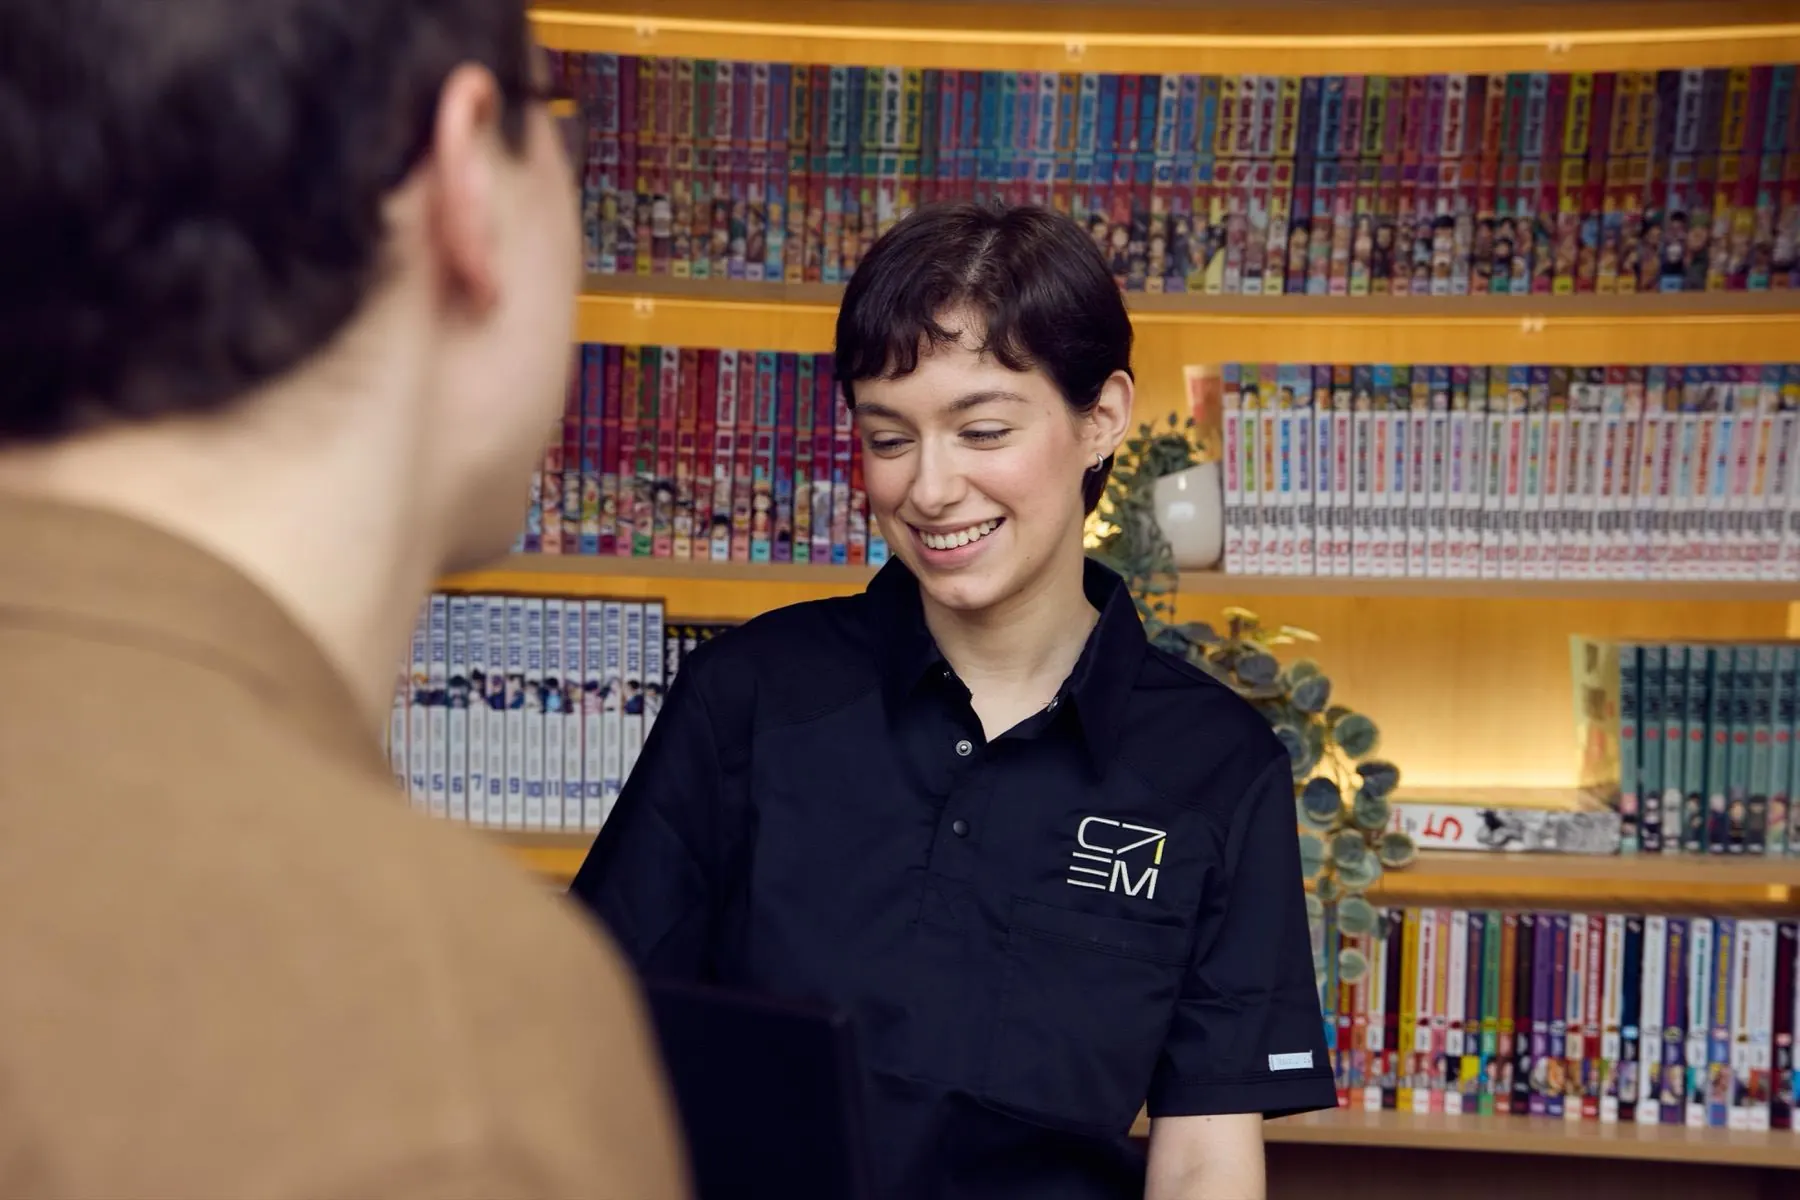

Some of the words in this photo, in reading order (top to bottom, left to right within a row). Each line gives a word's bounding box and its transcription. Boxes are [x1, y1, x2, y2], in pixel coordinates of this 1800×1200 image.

[1265, 540, 1277, 555] 4
[412, 774, 424, 791] 4
[432, 773, 443, 791] 5
[452, 776, 463, 794] 6
[471, 773, 482, 791] 7
[490, 778, 500, 796] 8
[510, 777, 520, 794] 9
[526, 781, 544, 798] 10
[547, 781, 559, 797] 11
[564, 782, 581, 799] 12
[1423, 814, 1463, 842] 5
